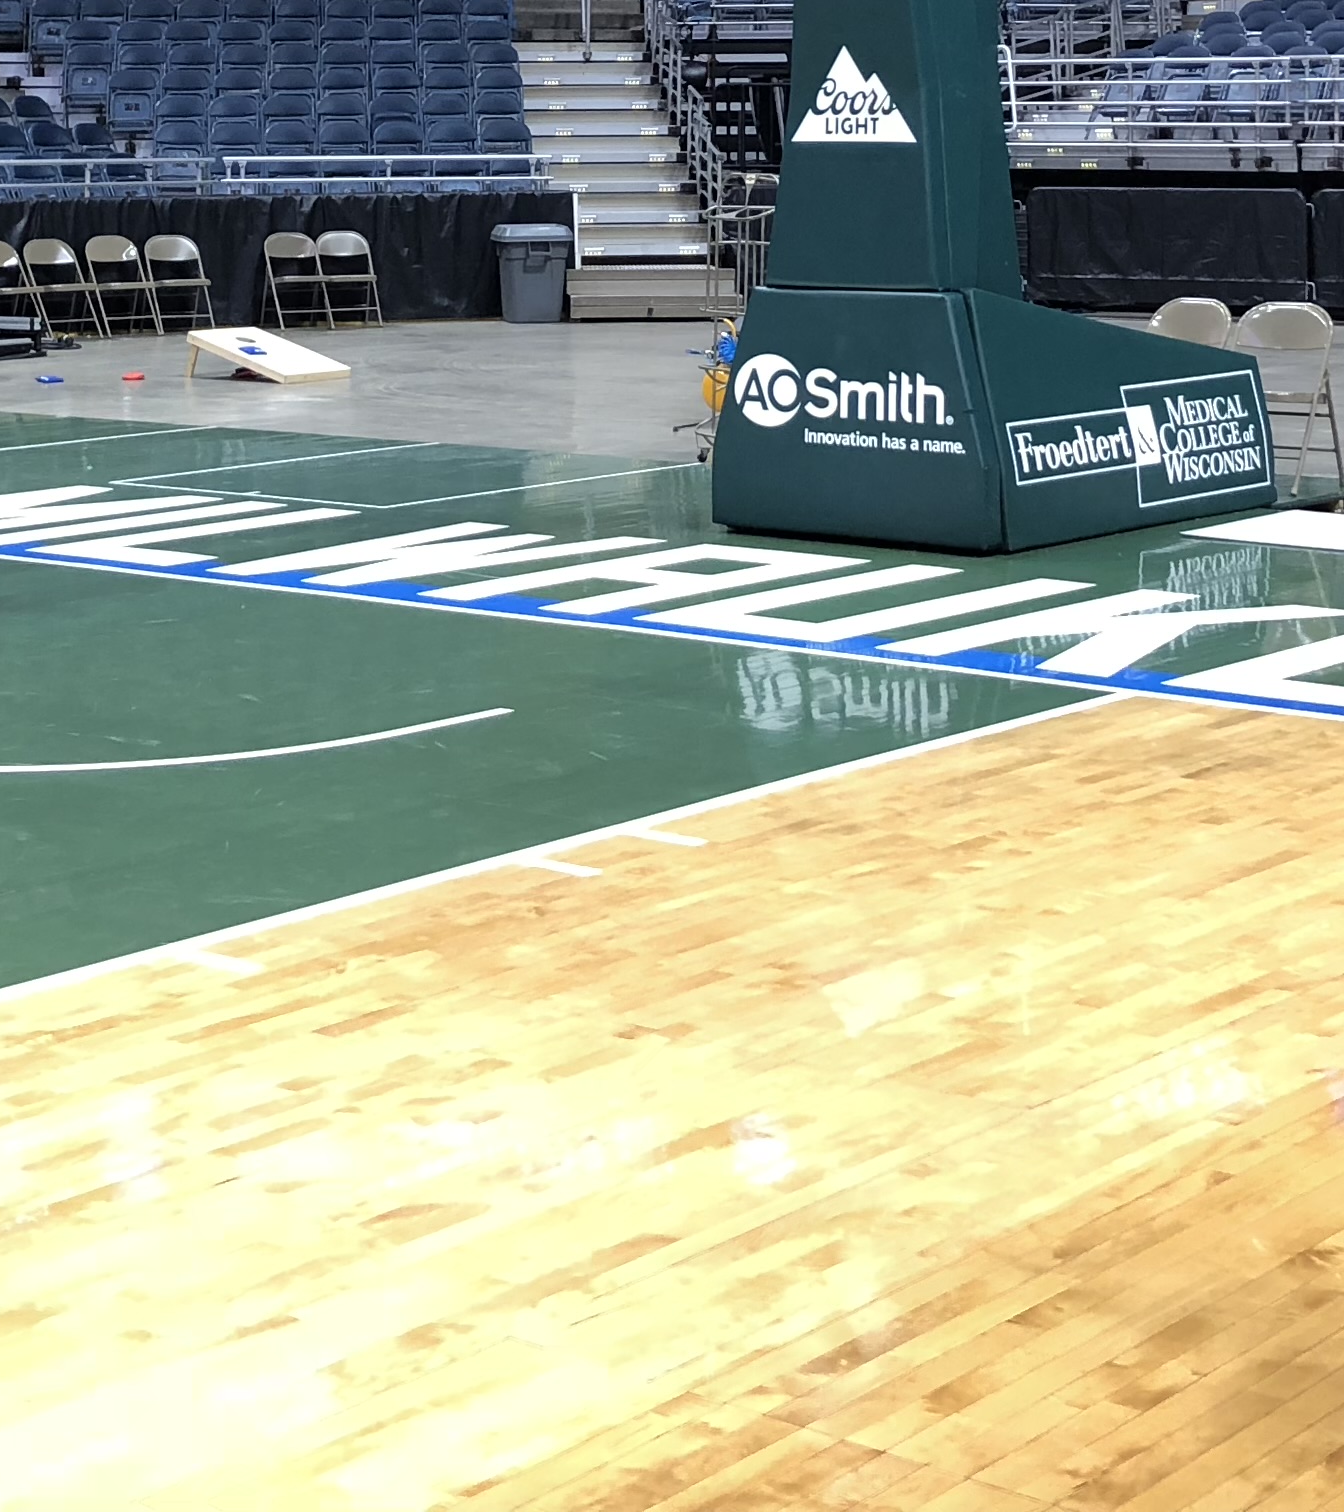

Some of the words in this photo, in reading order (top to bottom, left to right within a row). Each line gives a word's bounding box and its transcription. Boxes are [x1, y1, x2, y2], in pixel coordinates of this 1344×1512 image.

[811, 77, 897, 116] Coors
[825, 117, 880, 135] LIGHT
[804, 367, 945, 426] Smith
[1163, 394, 1249, 427] MEDICAL
[804, 428, 878, 448] Innovation
[882, 432, 906, 451] has
[910, 437, 920, 451] a
[923, 437, 966, 455] name.
[1014, 425, 1132, 474] Froedtert
[1159, 422, 1242, 455] COLLEGE
[1243, 424, 1256, 444] of
[1162, 446, 1262, 485] WISCONSIN
